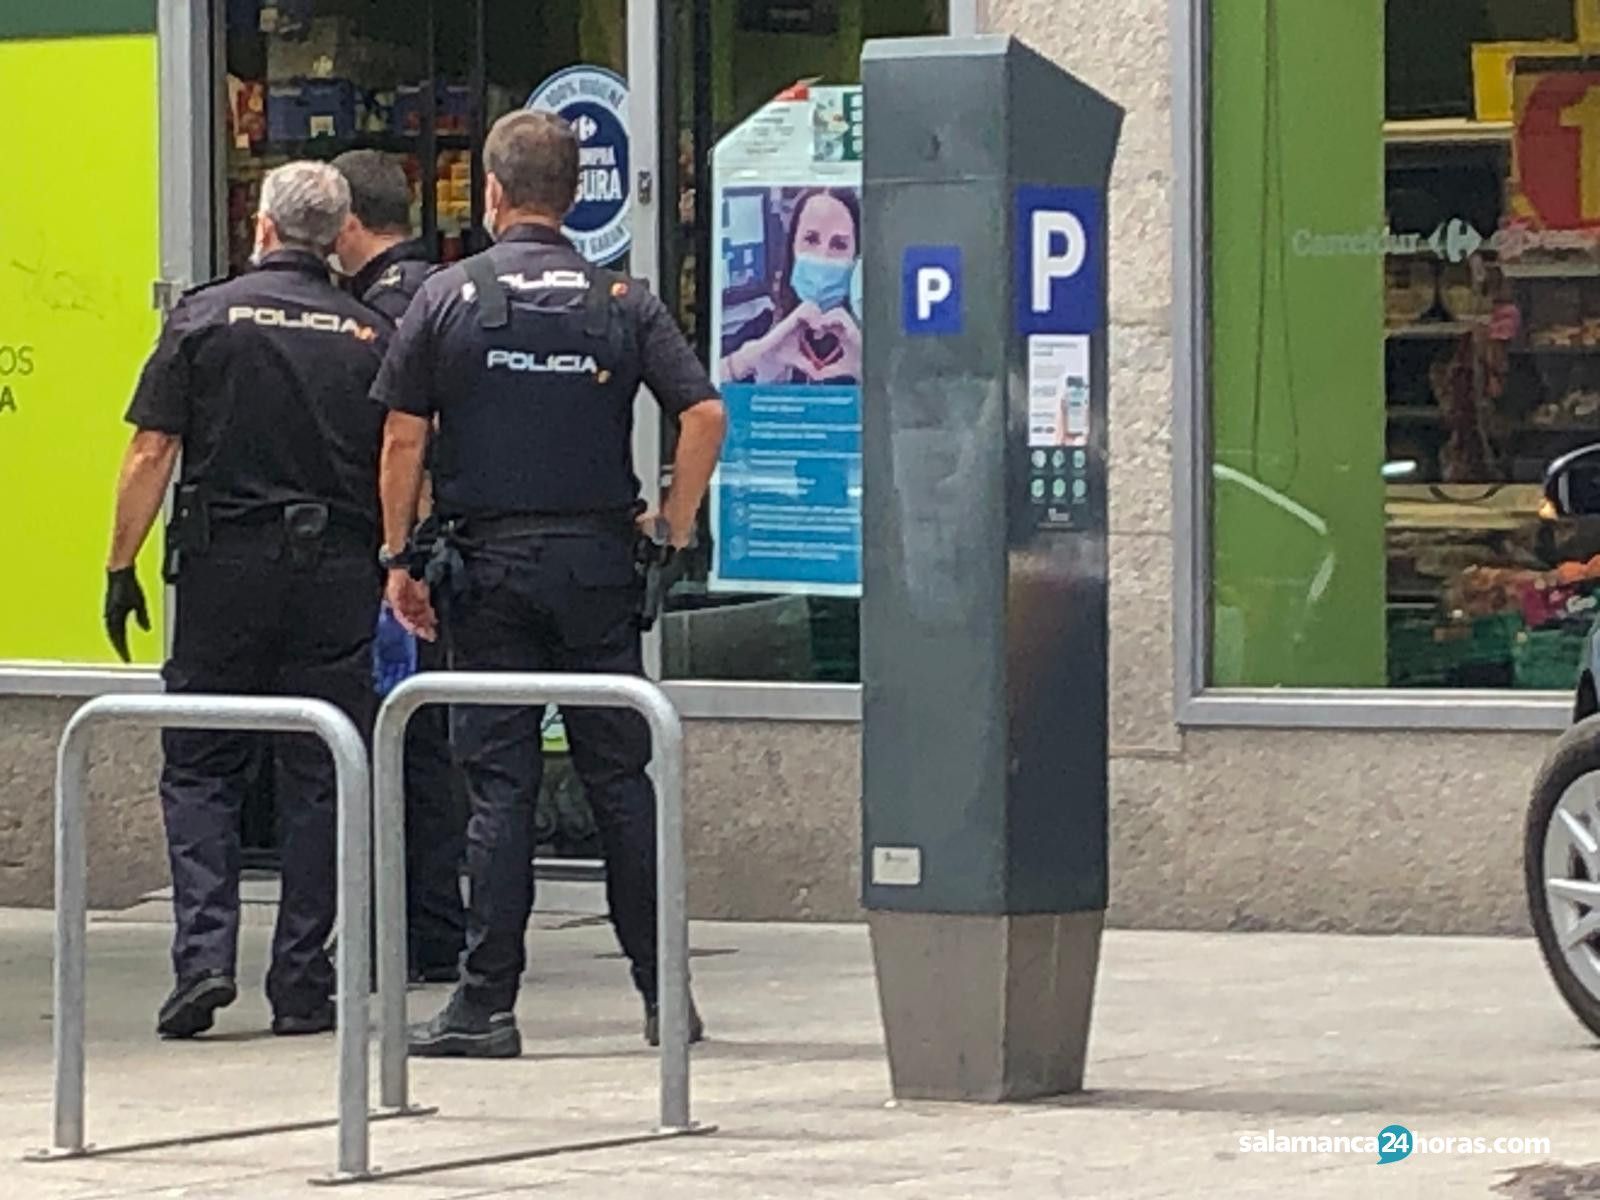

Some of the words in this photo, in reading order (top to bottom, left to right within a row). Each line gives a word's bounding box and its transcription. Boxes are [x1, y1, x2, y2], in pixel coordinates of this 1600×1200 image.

[573, 167, 623, 204] GURA
[1031, 210, 1087, 313] P
[462, 270, 590, 301] LICI
[917, 266, 952, 321] P
[228, 305, 360, 338] POLICIA
[487, 349, 598, 374] POLICIA
